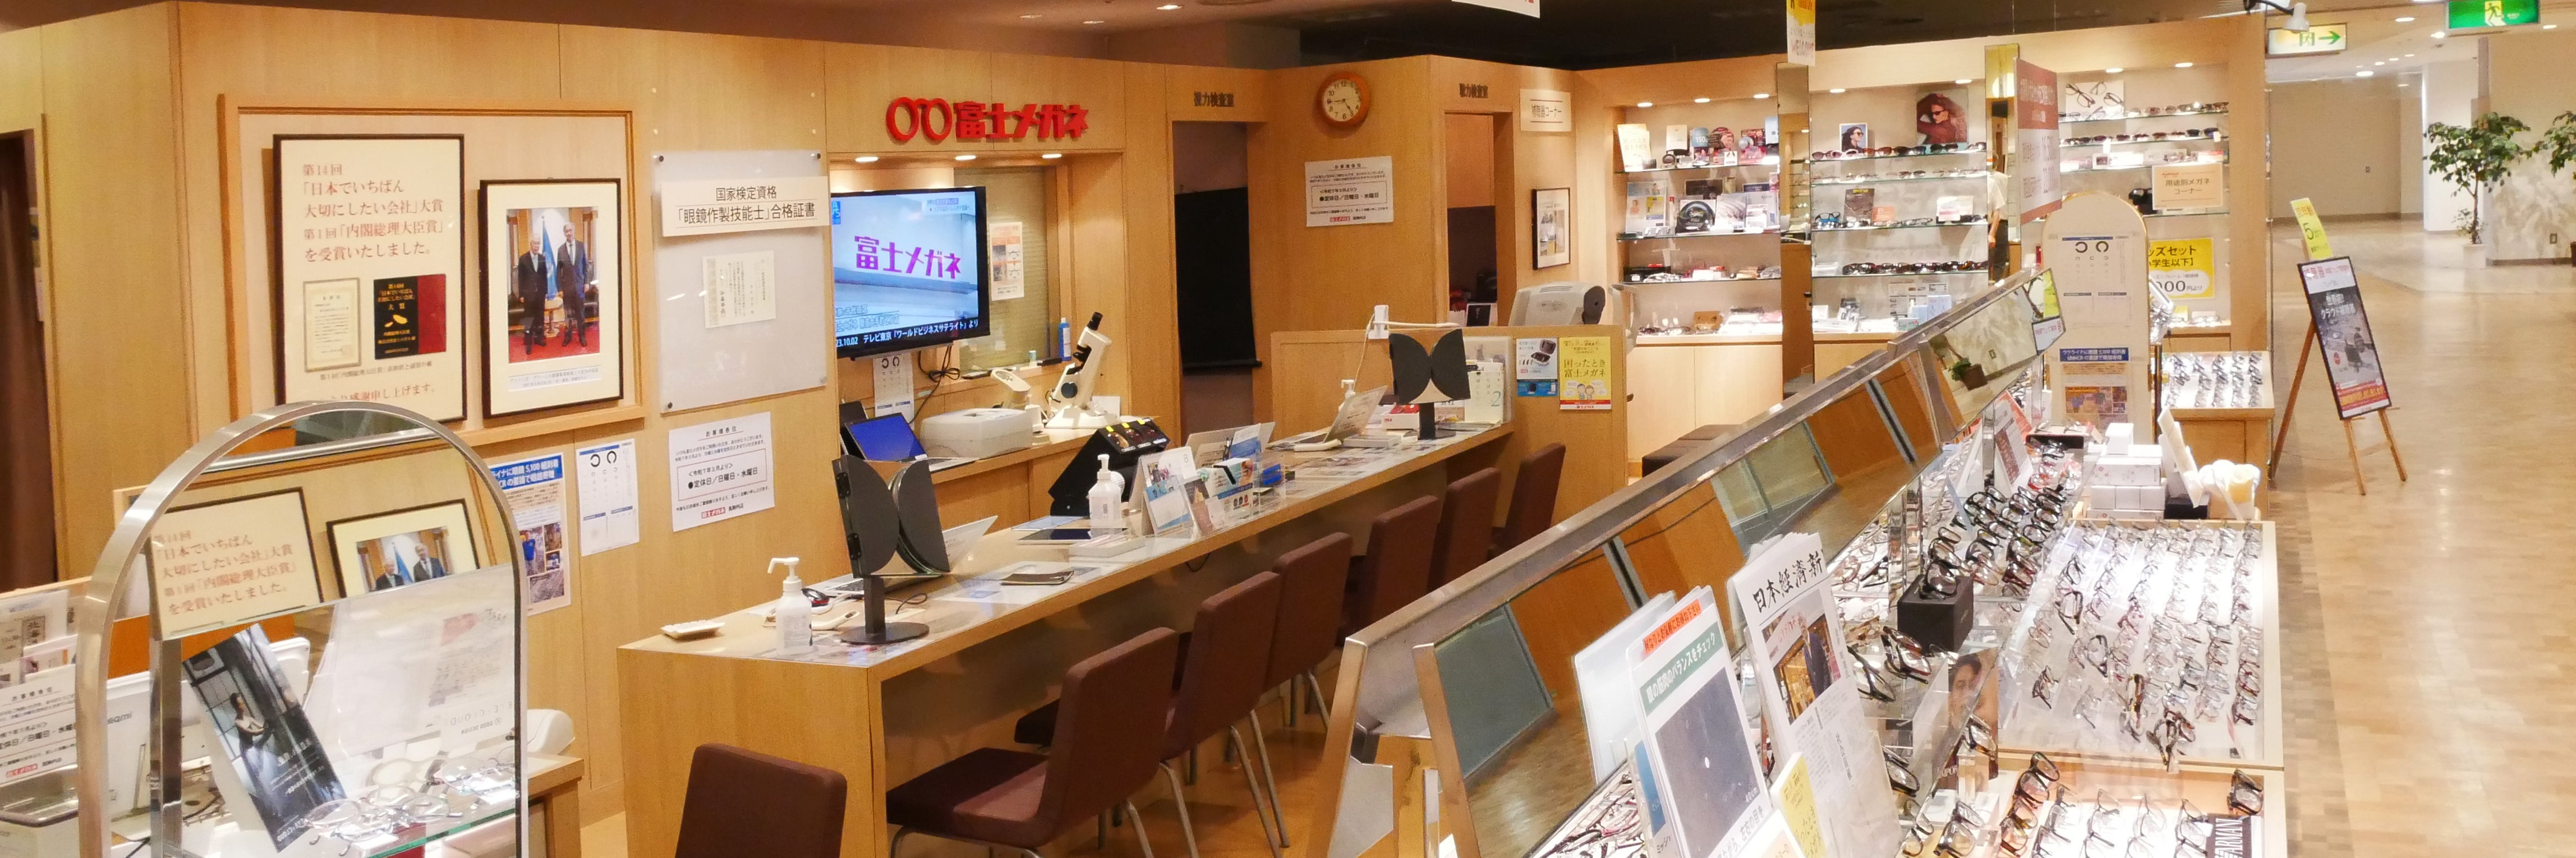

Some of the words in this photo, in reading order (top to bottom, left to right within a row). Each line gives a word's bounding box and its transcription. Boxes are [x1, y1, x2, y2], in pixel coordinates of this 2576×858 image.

[954, 102, 1088, 139] 富士メガネ
[303, 164, 342, 177] 第14回
[303, 179, 404, 196] 「日本でいちばん
[715, 185, 778, 202] 国家検定資格
[305, 199, 443, 218] 大切にしたい会社」大賞
[678, 202, 816, 225] 「眼鏡作製技能士」合格証書
[304, 219, 443, 241] 第1回「内閣総理大臣賞」
[305, 241, 431, 262] を受賞いたしました。
[854, 235, 962, 280] 富士メガネ
[863, 331, 892, 344] テレビ東京
[969, 319, 979, 329] より
[1564, 359, 1606, 368] 困ったとき
[1564, 369, 1606, 378] 富士メガネ
[1491, 391, 1501, 407] 2
[706, 426, 737, 437] お客様各位
[2215, 818, 2243, 855] ARMANI
